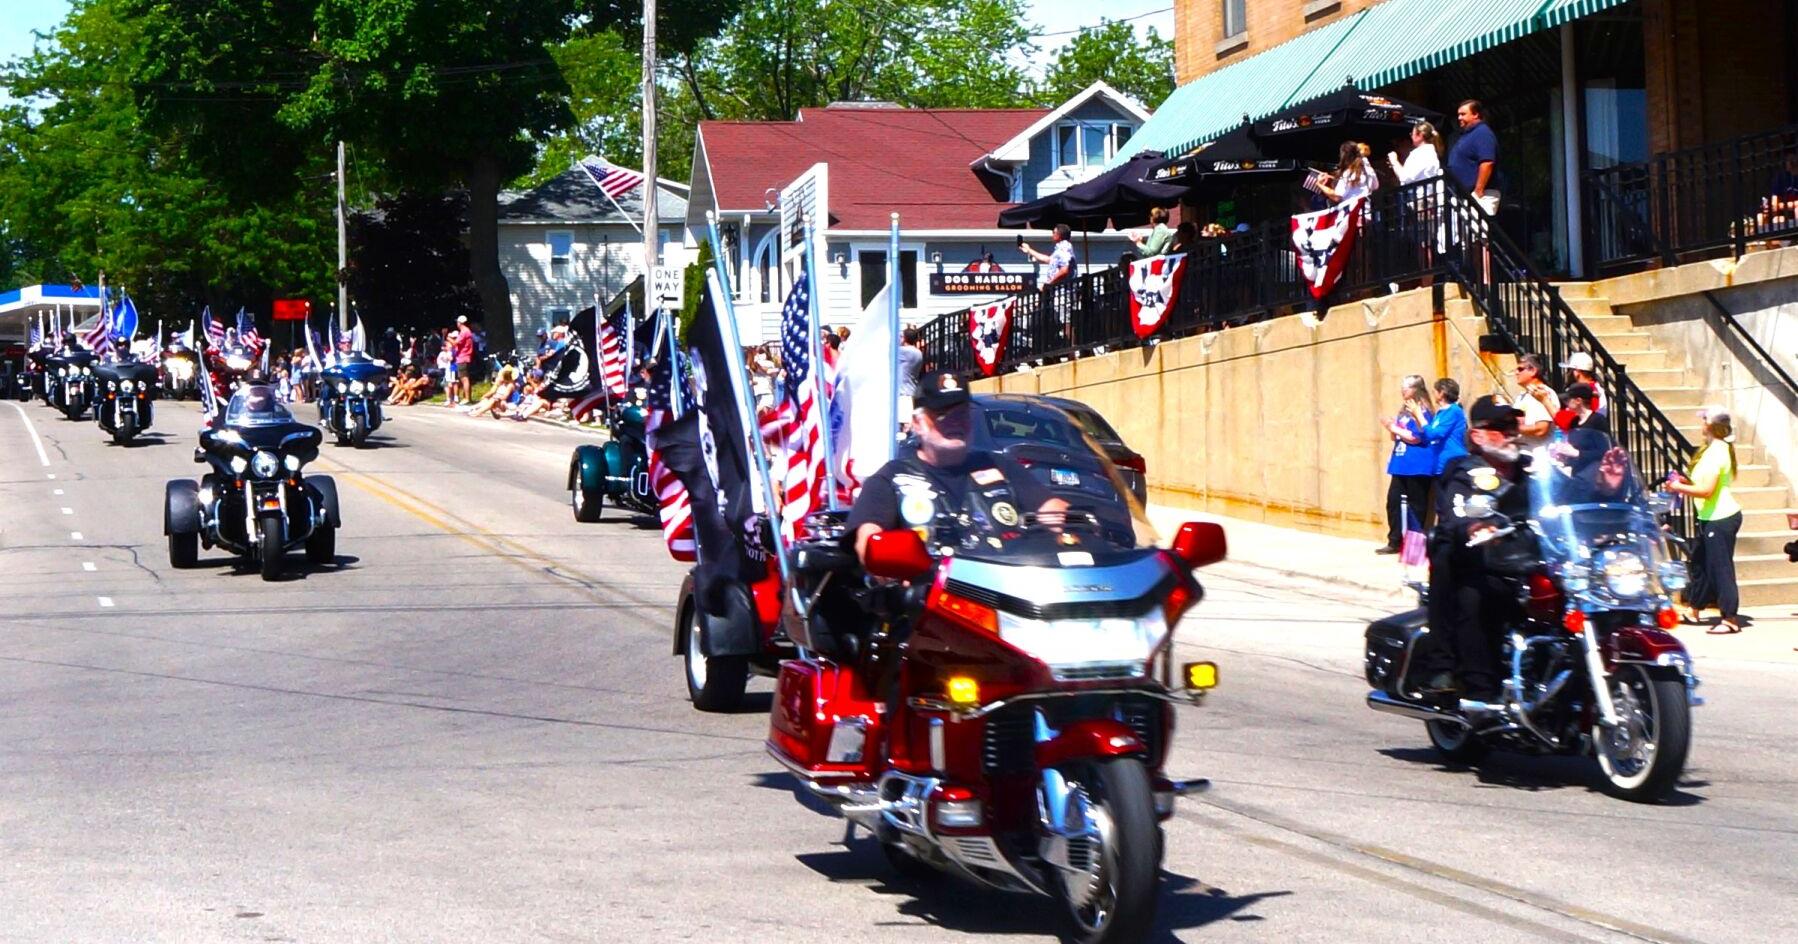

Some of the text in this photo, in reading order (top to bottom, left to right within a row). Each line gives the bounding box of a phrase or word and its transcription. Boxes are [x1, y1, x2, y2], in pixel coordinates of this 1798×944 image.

[1272, 118, 1299, 132] Tito's
[1213, 160, 1240, 171] Tito's
[655, 269, 680, 280] ONE
[944, 275, 1023, 284] DOG HARBOR
[655, 281, 680, 292] WAY
